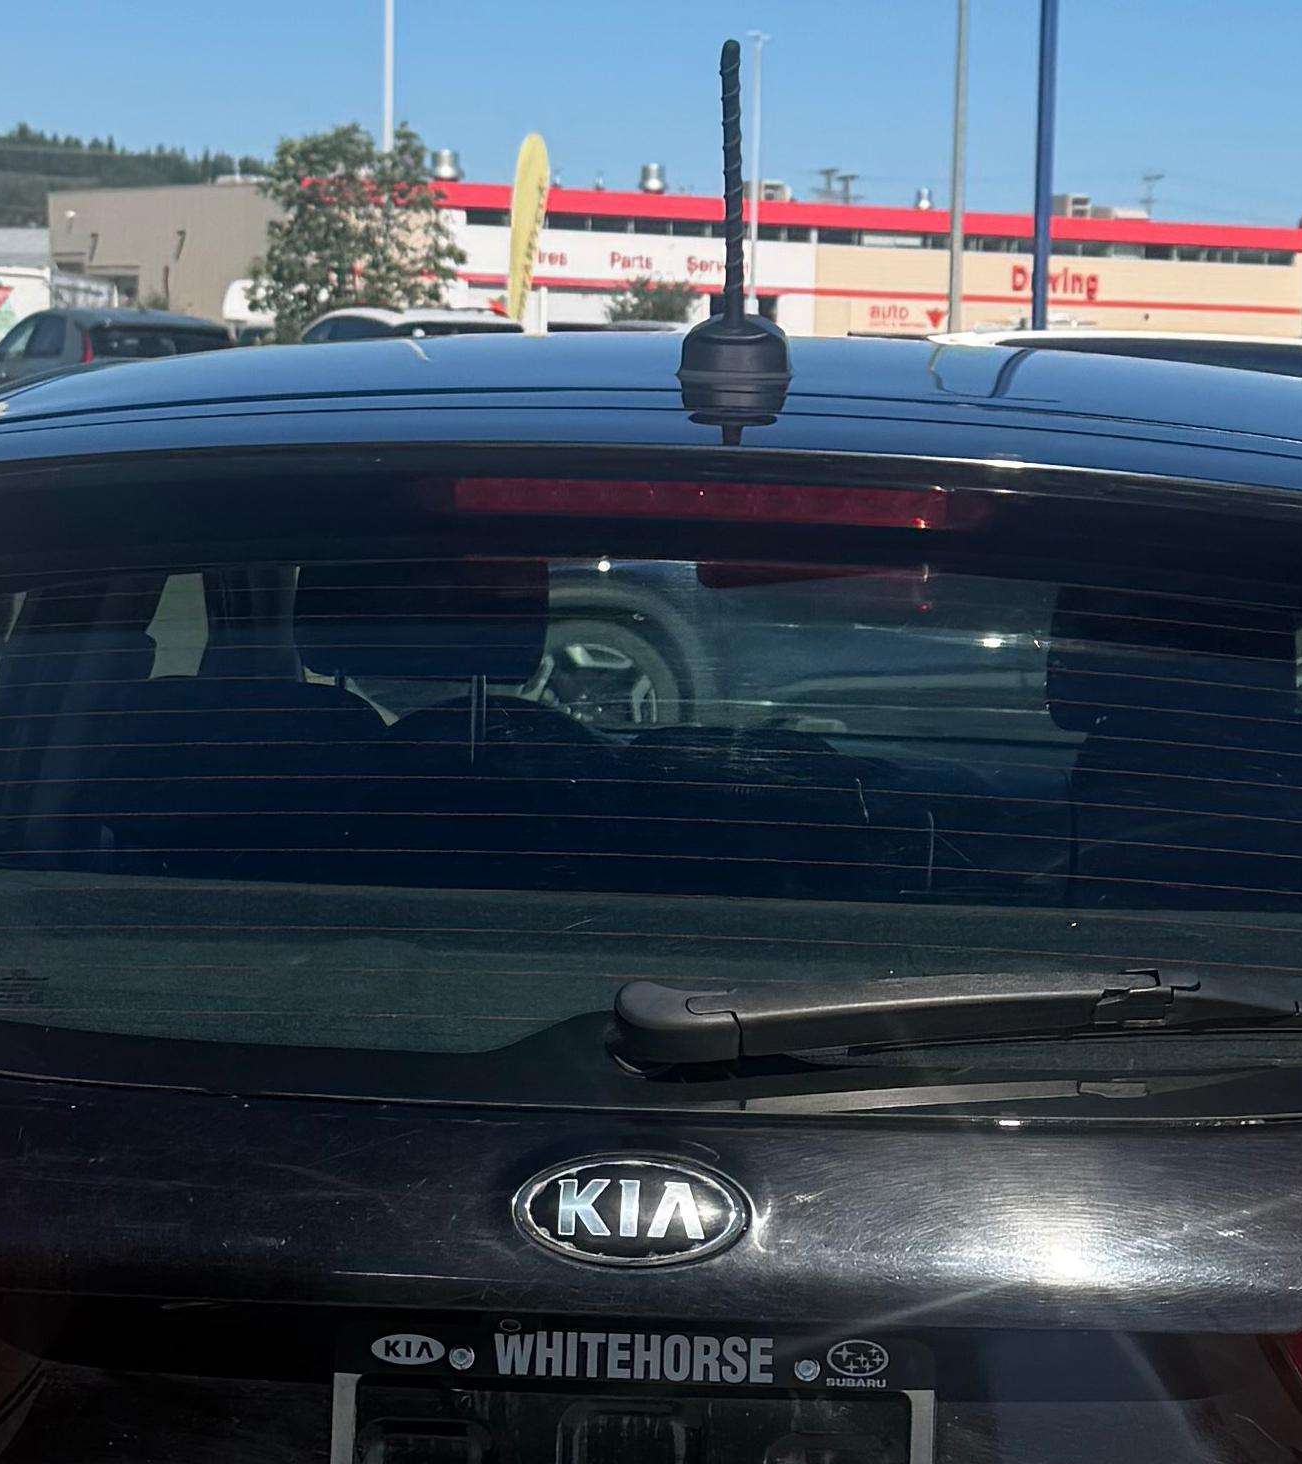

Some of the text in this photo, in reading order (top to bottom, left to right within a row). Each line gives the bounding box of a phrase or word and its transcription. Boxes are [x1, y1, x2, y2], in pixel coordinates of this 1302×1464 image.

[537, 249, 568, 266] ires
[609, 251, 653, 270] Parts
[1012, 264, 1099, 301] Dving
[557, 1178, 705, 1240] KIA
[494, 1330, 774, 1384] WHITEHORSE
[826, 1378, 887, 1388] SUBARU
